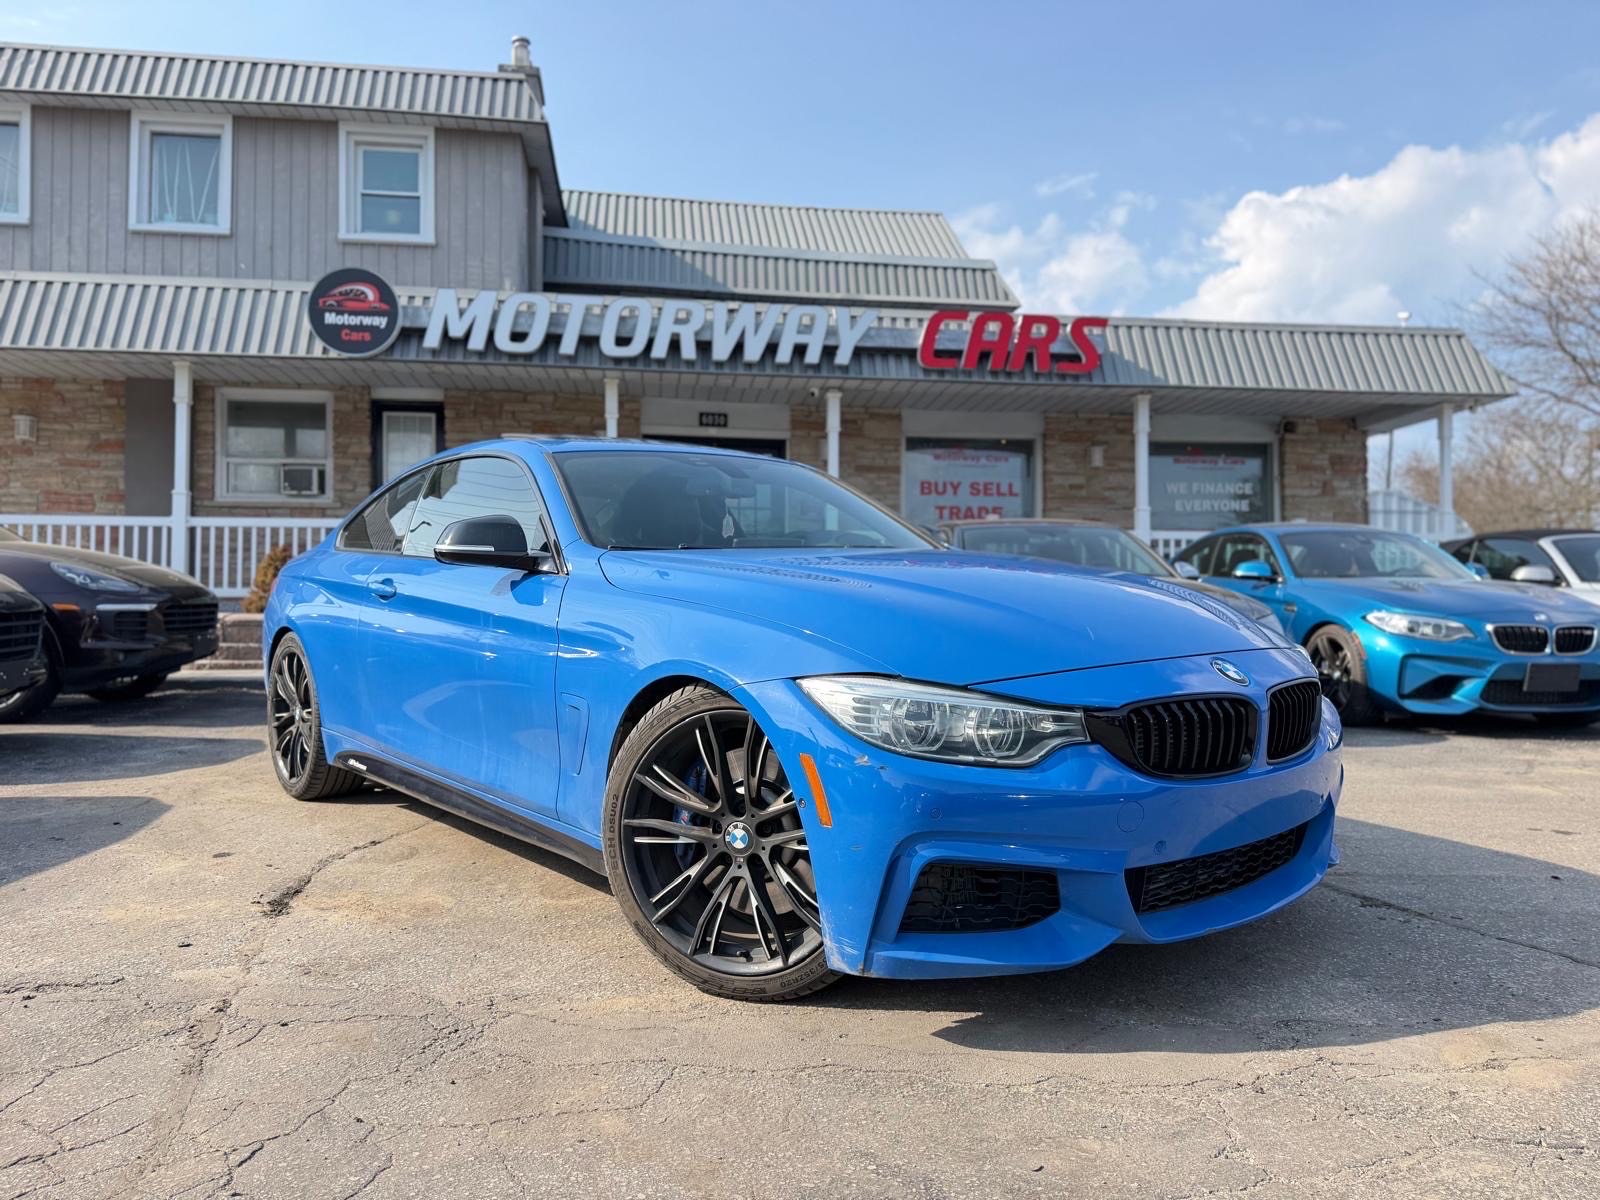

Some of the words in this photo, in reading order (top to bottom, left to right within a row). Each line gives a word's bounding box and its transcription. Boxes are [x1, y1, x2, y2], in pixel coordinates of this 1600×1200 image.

[324, 312, 388, 329] Motorway
[341, 328, 371, 341] Cars
[422, 287, 878, 366] MOTORWAY
[916, 309, 1109, 374] CARS
[920, 480, 961, 496] BUY
[969, 481, 1019, 497] SELL
[1166, 482, 1188, 494] WE
[1192, 482, 1253, 495] FINANCE
[935, 506, 1003, 520] TRADE
[1175, 500, 1250, 512] EVERYONE
[725, 823, 744, 841] BMW
